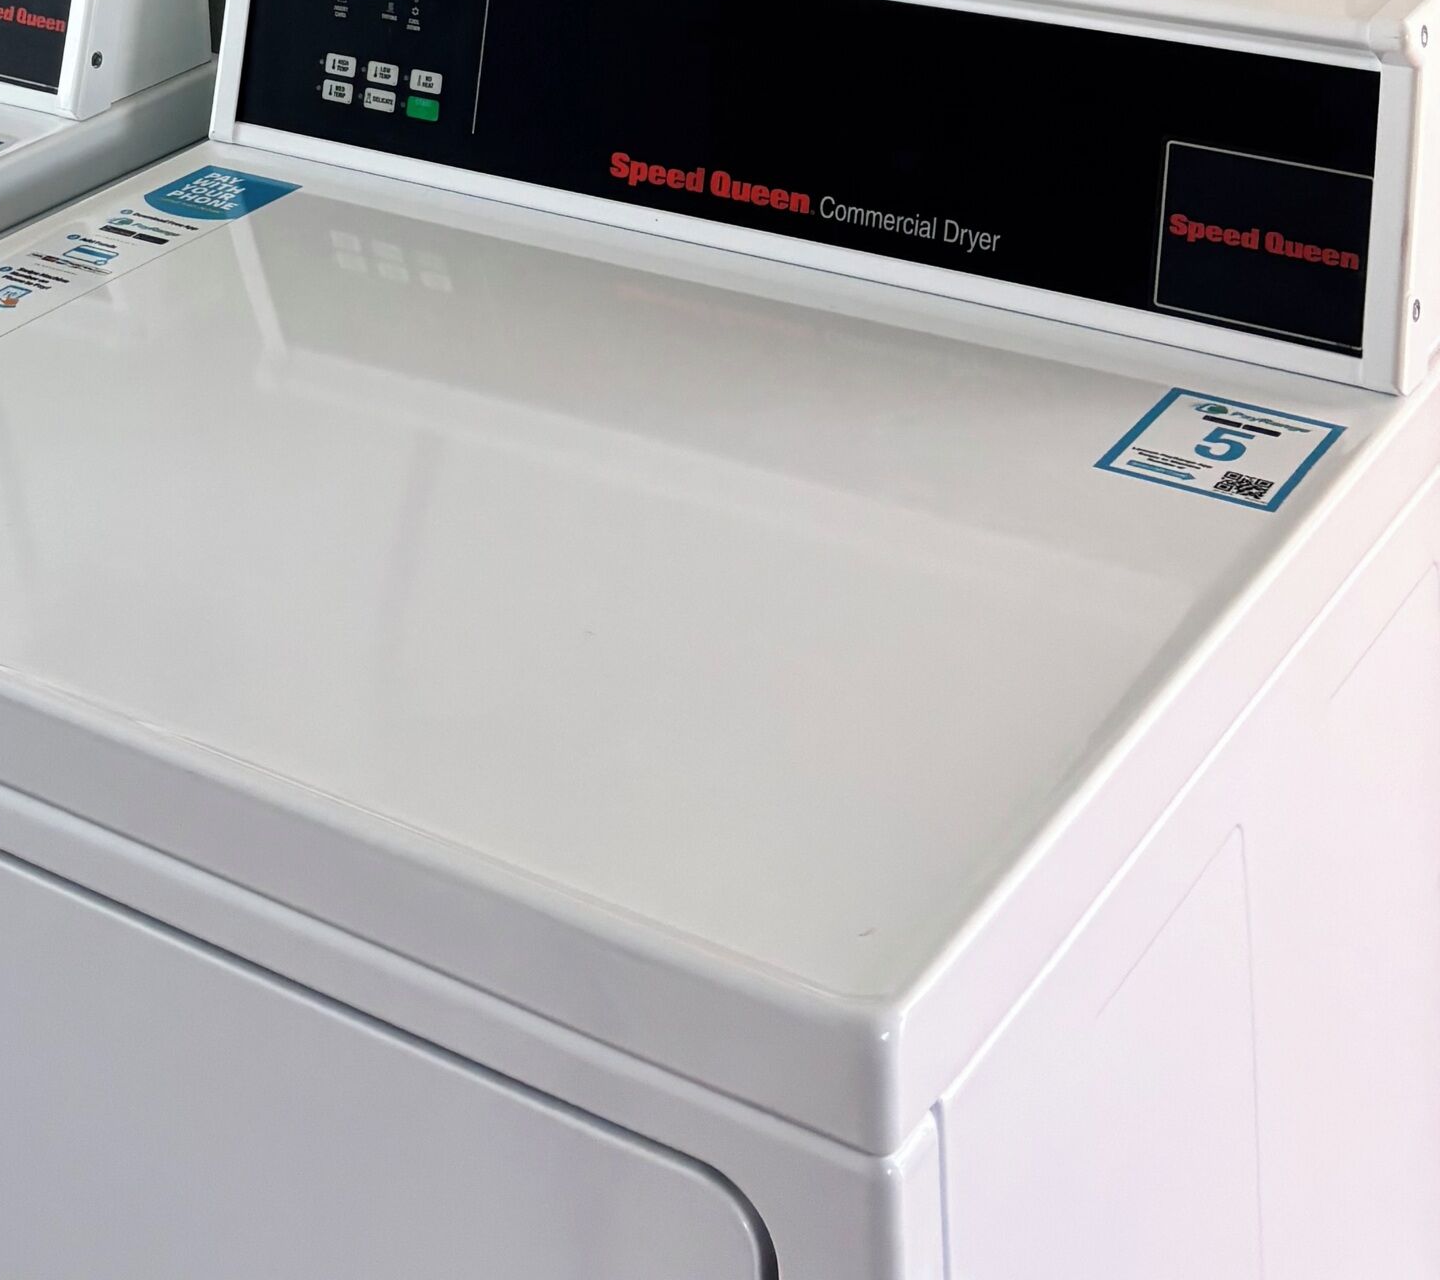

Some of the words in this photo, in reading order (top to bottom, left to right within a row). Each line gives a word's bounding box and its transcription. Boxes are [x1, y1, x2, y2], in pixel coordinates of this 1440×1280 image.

[15, 7, 66, 33] Queen
[372, 95, 394, 106] DELICATE
[192, 178, 247, 194] WITH
[204, 172, 246, 184] PAY
[166, 190, 240, 211] PHONE
[181, 183, 237, 201] YOUR
[609, 151, 706, 193] Speed
[710, 170, 811, 215] Queen
[820, 195, 937, 240] Commercial
[944, 219, 1001, 252] Dryer
[1169, 213, 1260, 250] Speed
[1264, 230, 1360, 271] Queen
[1194, 426, 1256, 462] 5
